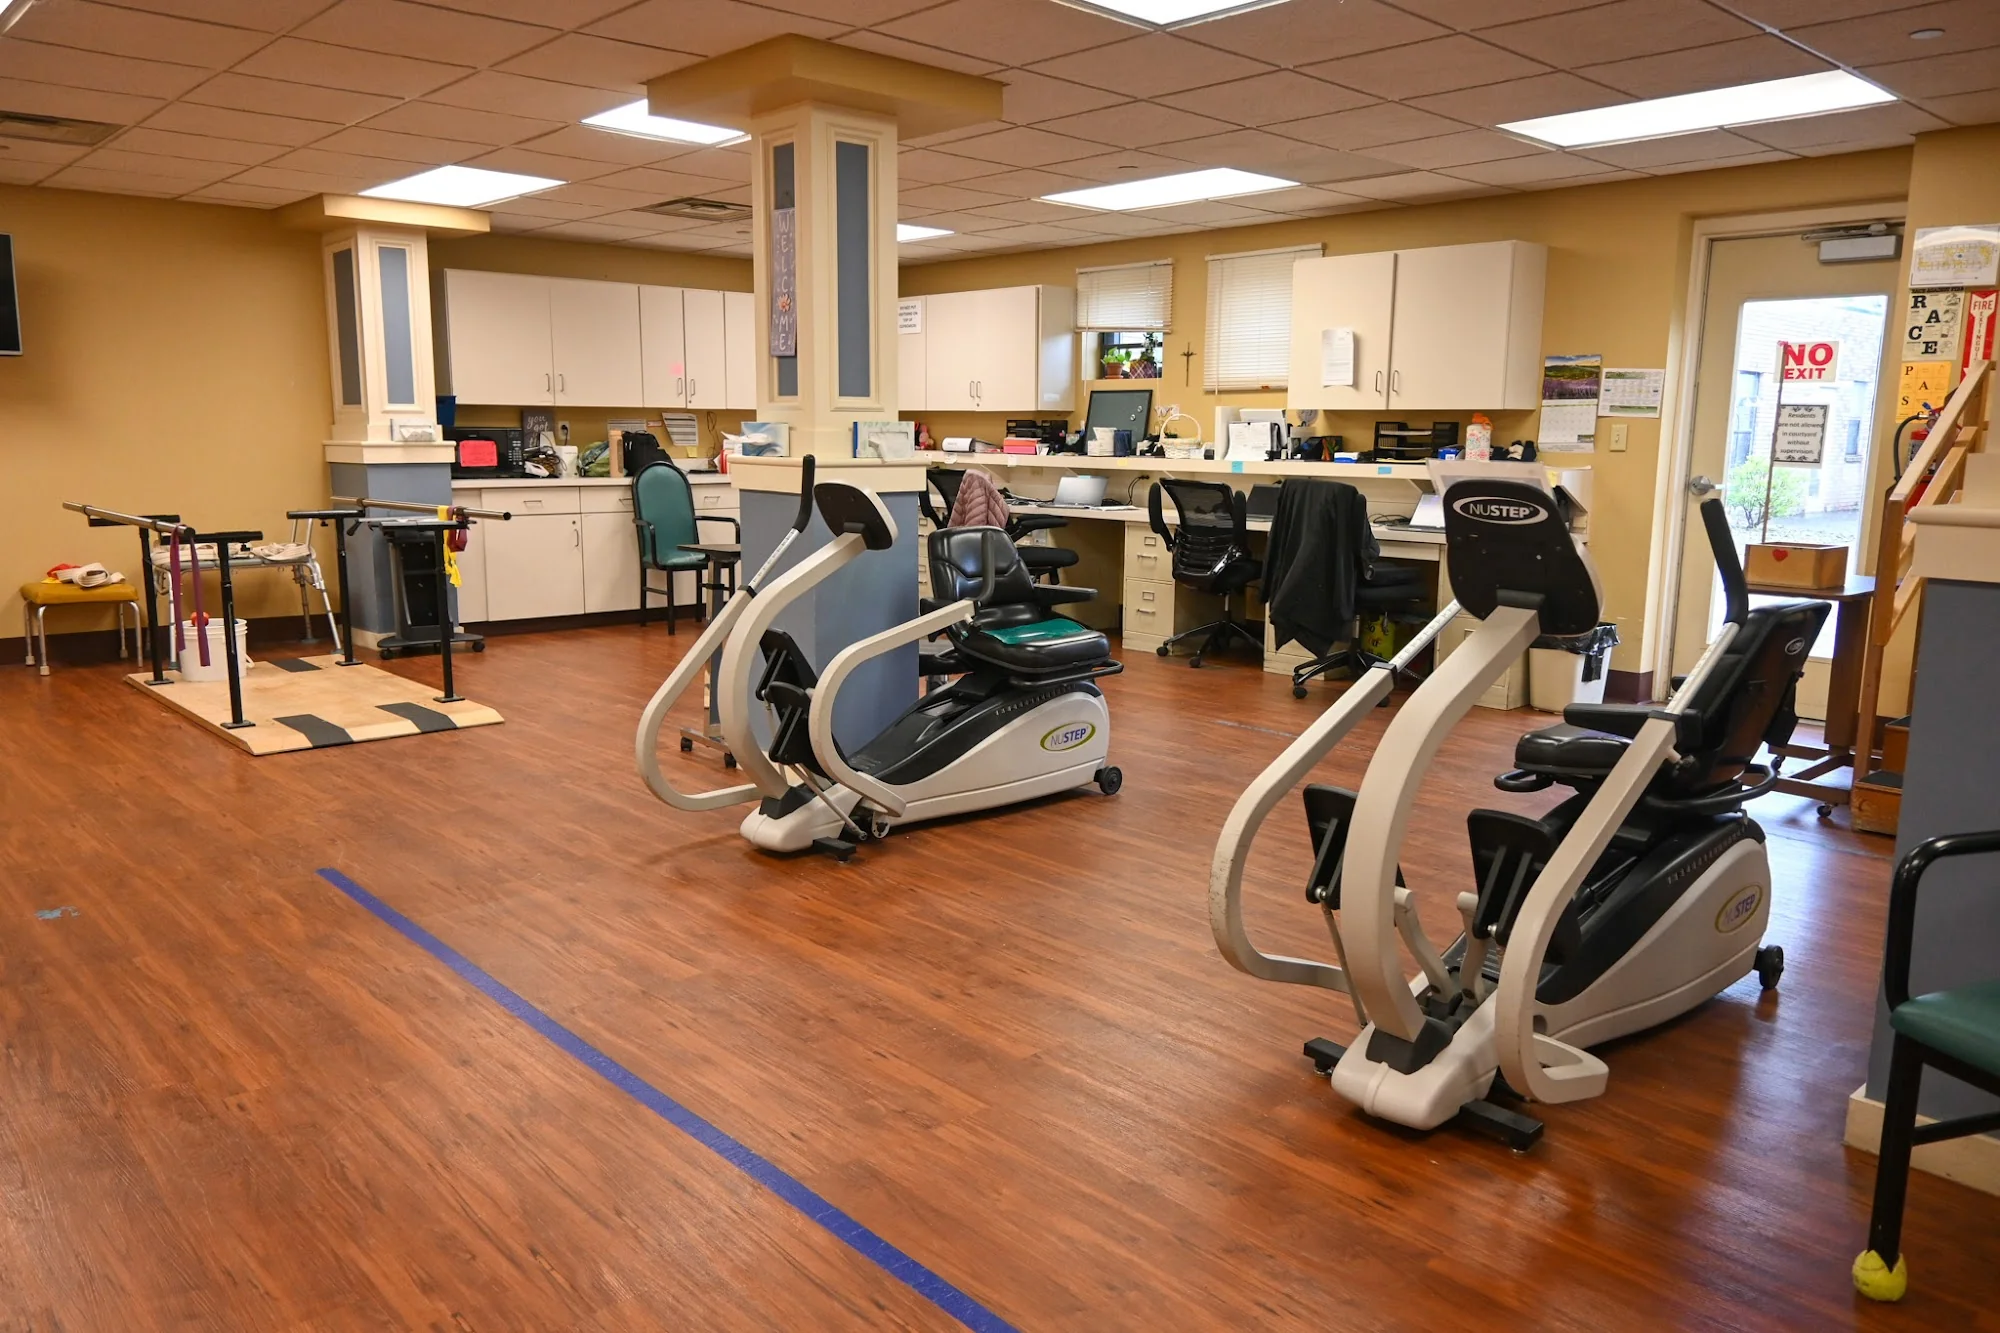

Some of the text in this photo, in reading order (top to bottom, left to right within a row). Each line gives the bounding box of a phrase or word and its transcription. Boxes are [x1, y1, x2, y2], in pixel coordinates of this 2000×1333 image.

[1973, 300, 1994, 310] FIRE
[1785, 343, 1833, 366] NO
[1783, 368, 1826, 379] EXIT
[527, 415, 547, 430] you
[1469, 503, 1530, 518] NUSTEP
[1051, 728, 1086, 747] NUSTEP
